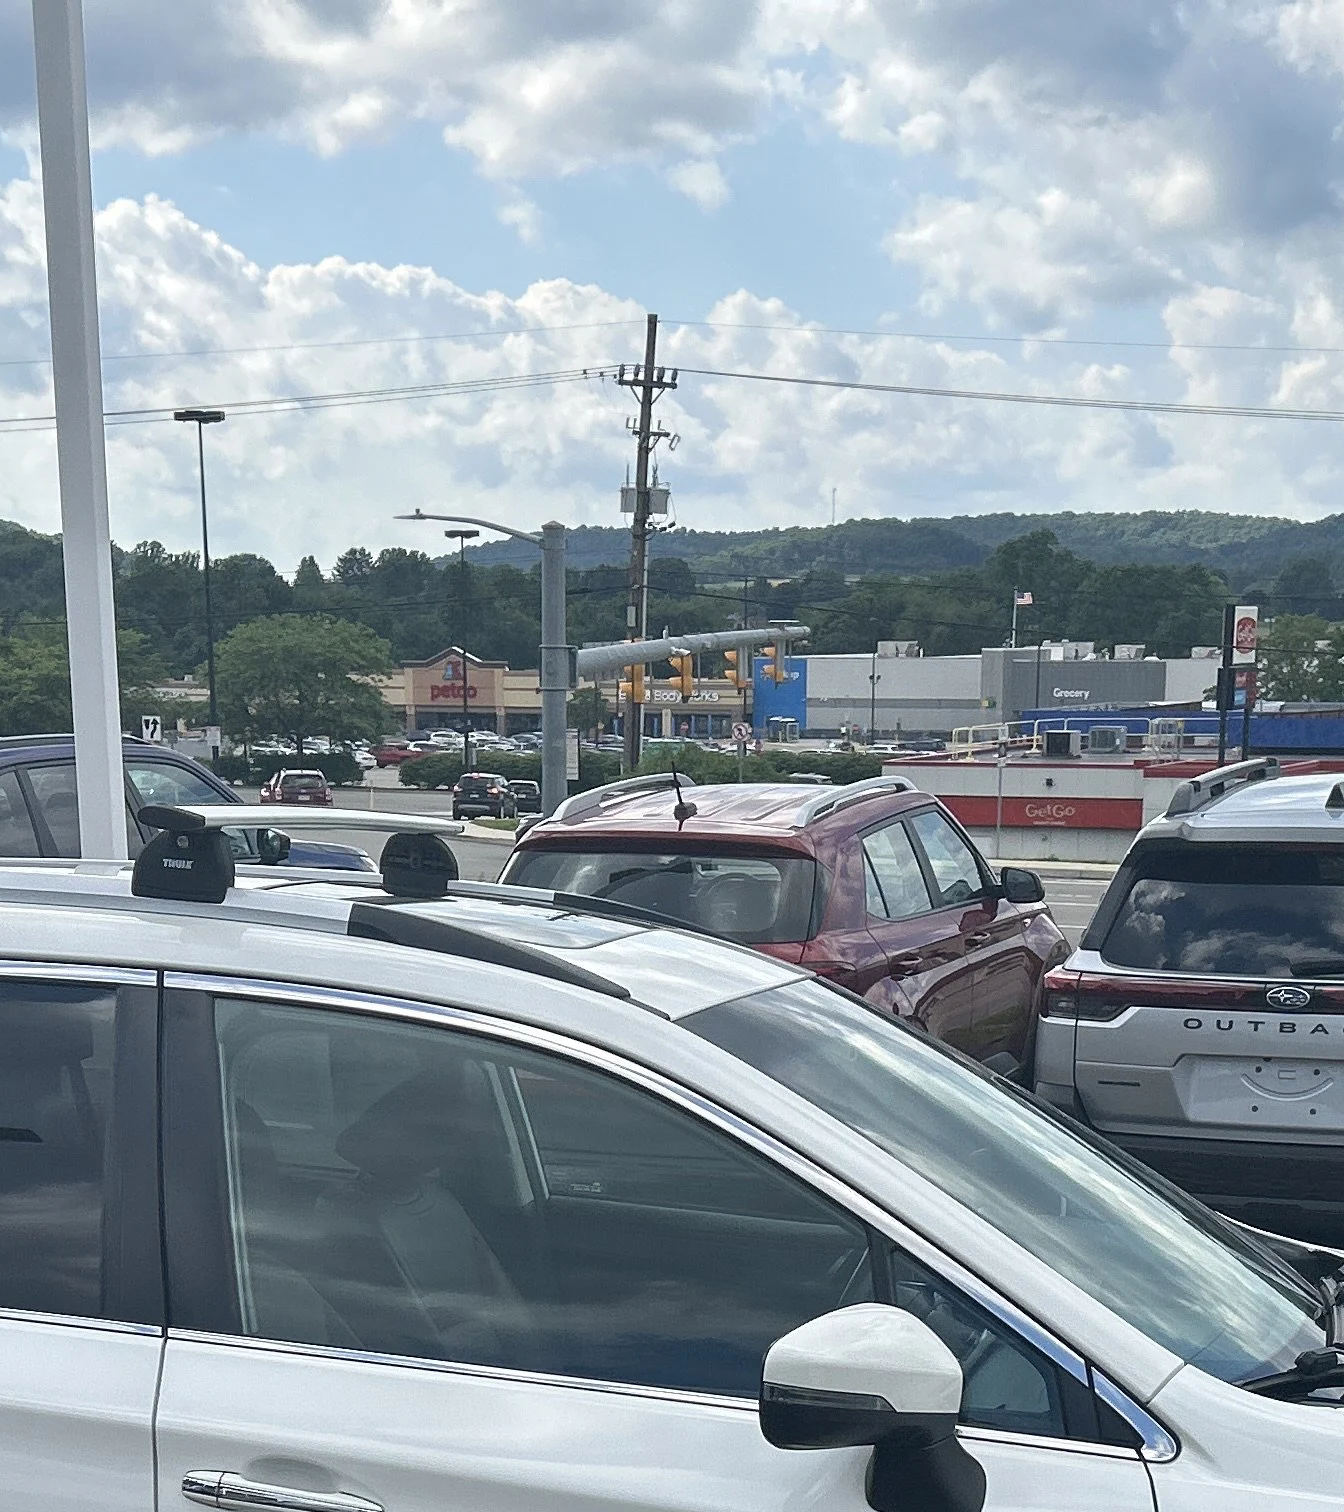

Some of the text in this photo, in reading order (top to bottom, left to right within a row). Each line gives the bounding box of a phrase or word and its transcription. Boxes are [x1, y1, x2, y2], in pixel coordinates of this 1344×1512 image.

[431, 683, 478, 701] petco
[1053, 687, 1090, 700] Grocery
[1025, 803, 1075, 818] GetGo
[162, 858, 194, 870] THULE
